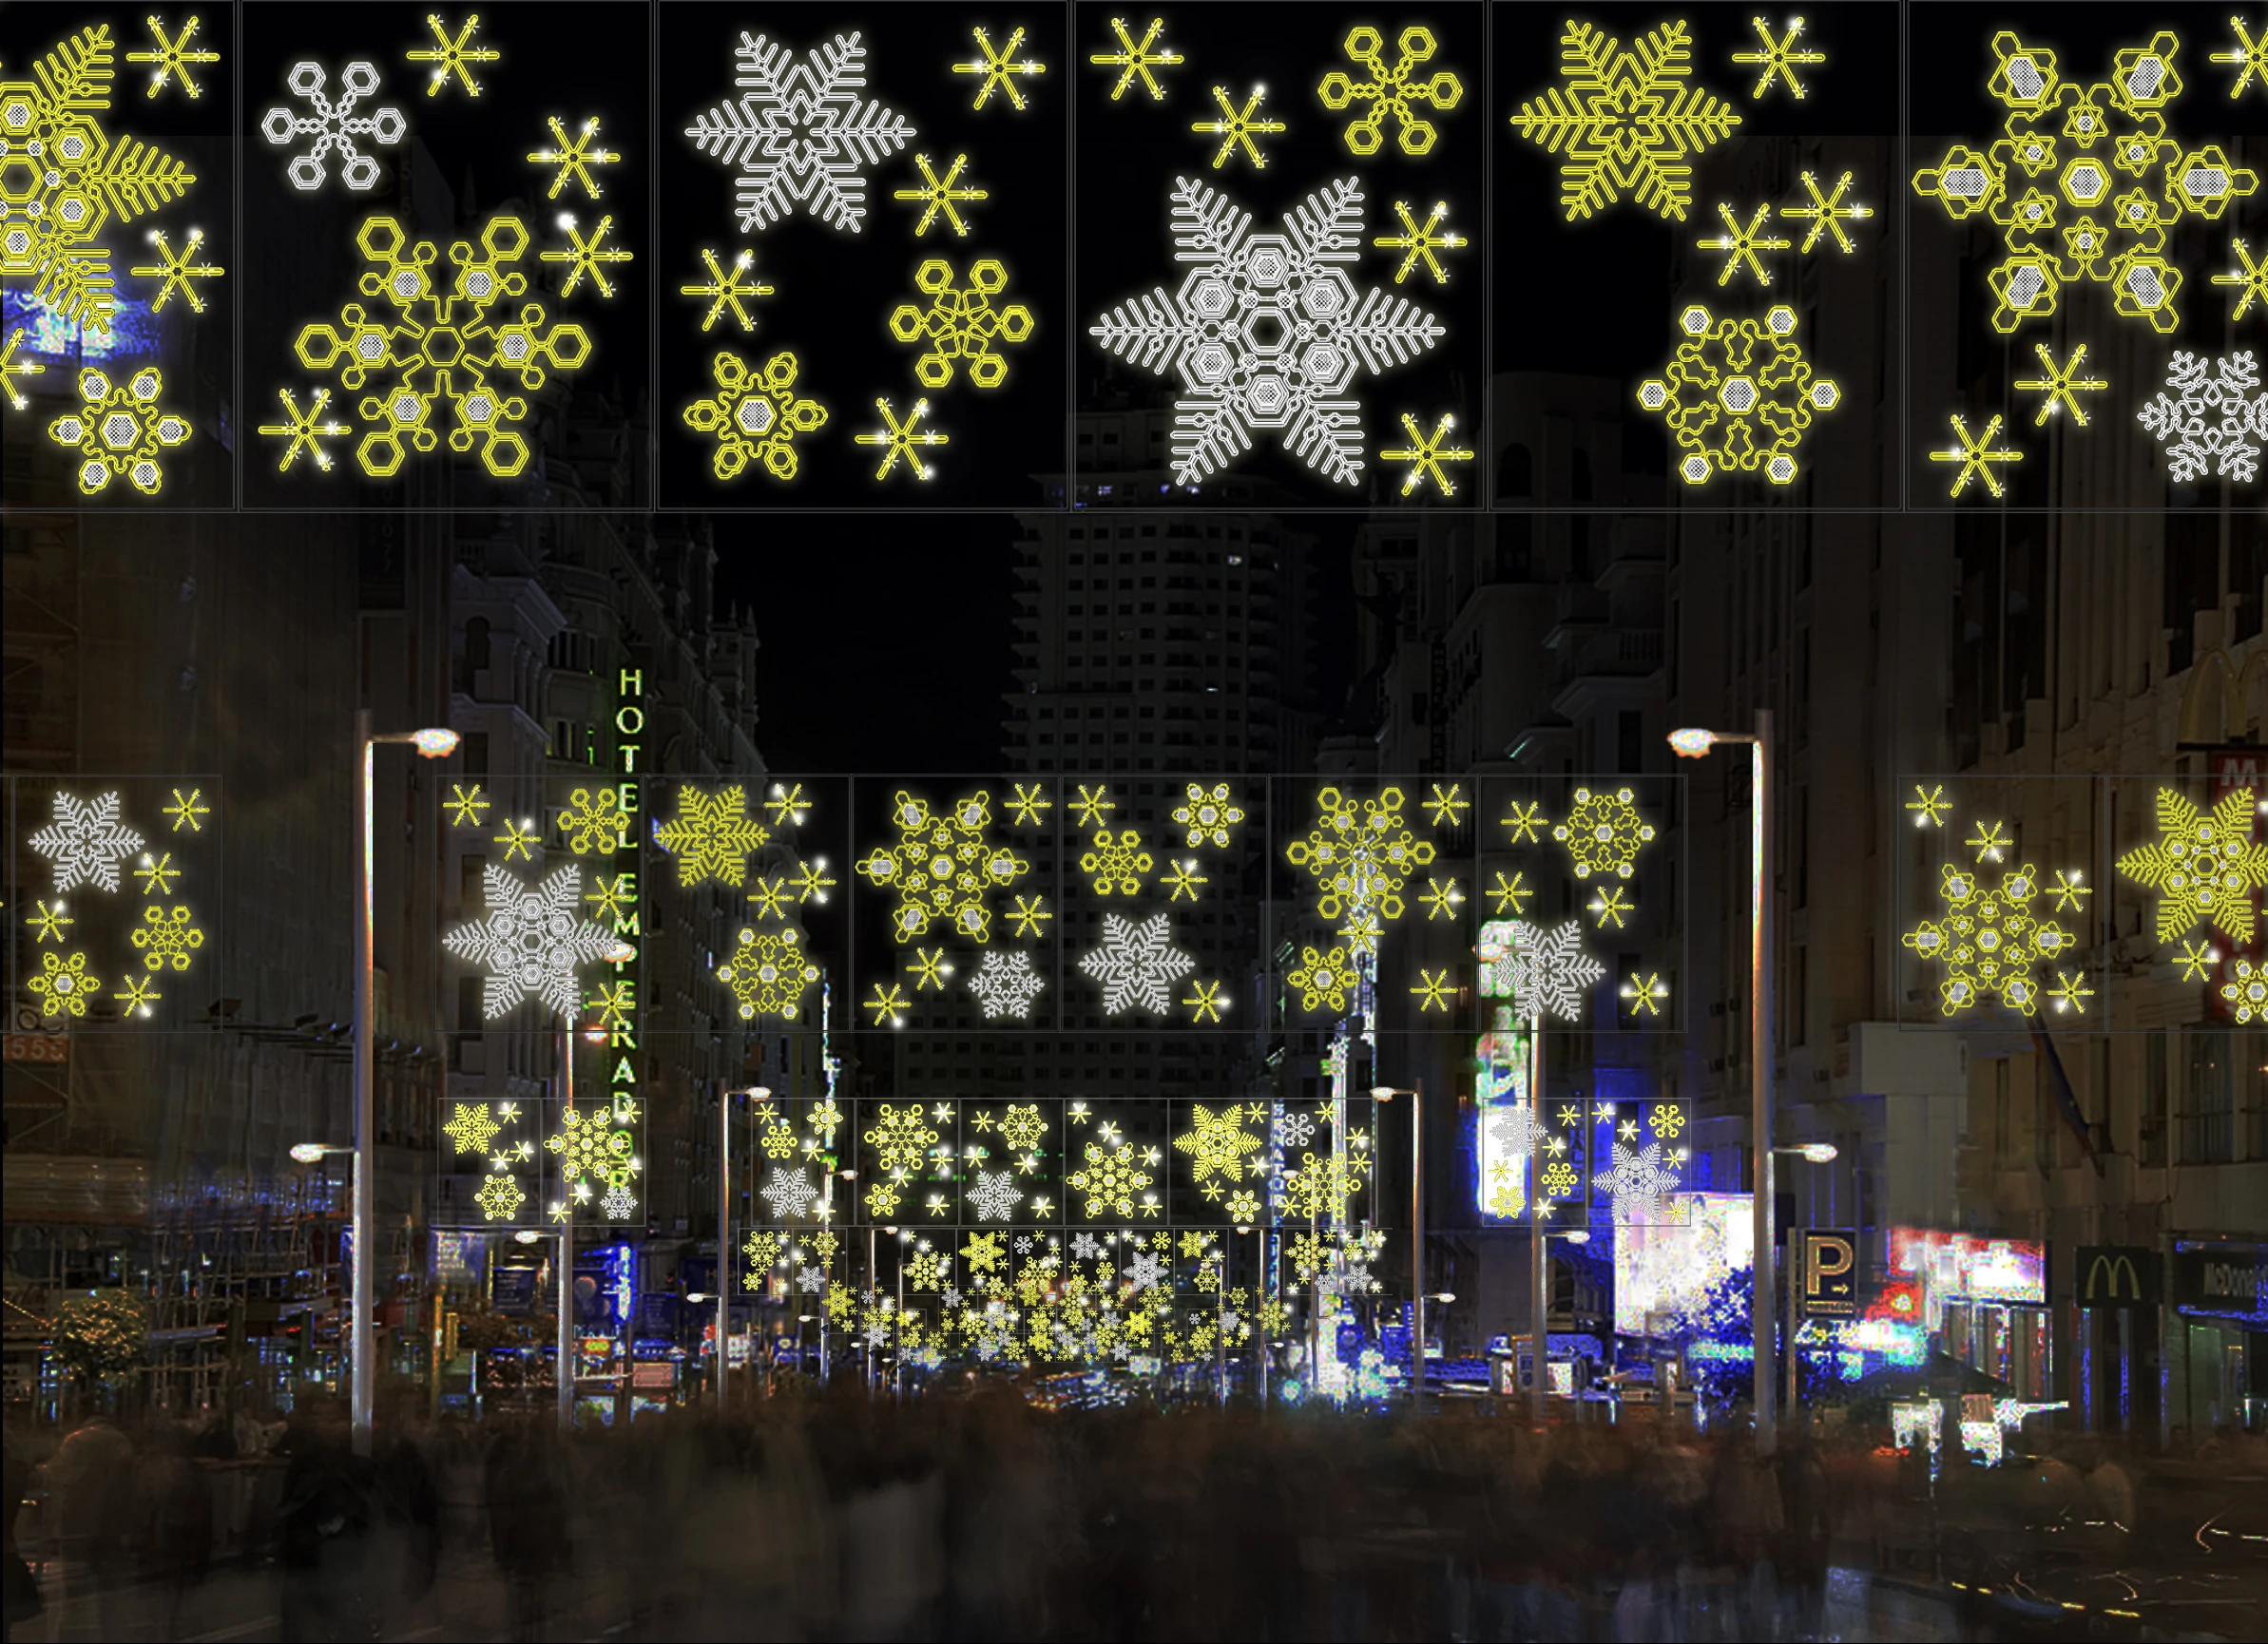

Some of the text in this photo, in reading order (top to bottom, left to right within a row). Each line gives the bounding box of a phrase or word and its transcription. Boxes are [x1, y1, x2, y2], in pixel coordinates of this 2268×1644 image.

[616, 668, 644, 849] HOTEL
[3, 1038, 64, 1060] 555
[1807, 1236, 1853, 1295] P
[2203, 1262, 2268, 1297] McDona
